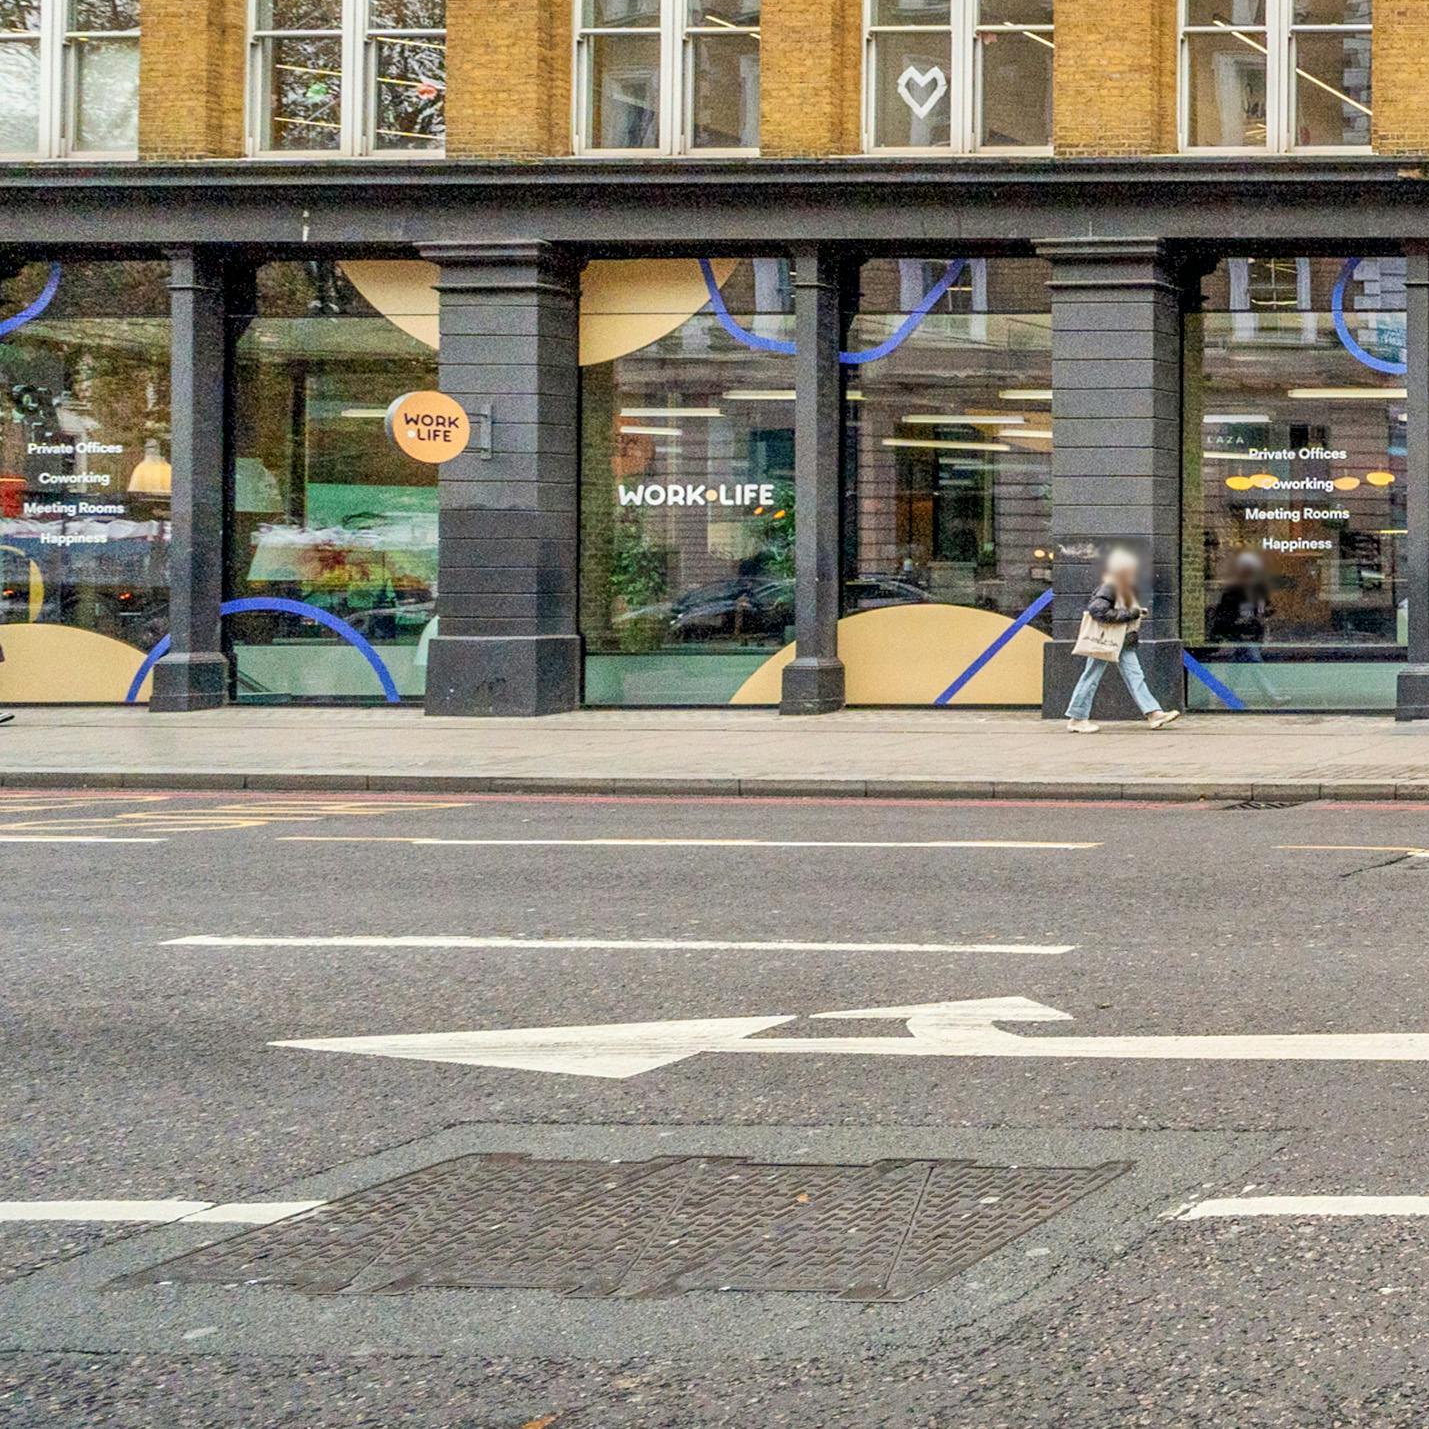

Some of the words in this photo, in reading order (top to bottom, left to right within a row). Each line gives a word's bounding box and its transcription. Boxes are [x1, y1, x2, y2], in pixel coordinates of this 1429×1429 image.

[404, 413, 459, 429] WORK
[28, 443, 73, 455] Private
[76, 442, 123, 454] Offices
[1249, 448, 1296, 459] Private
[1300, 447, 1347, 459] Offices
[39, 472, 110, 486] Coworking
[1262, 477, 1334, 492] Coworking
[24, 502, 76, 516] Meeting
[79, 502, 124, 513] Rooms
[1245, 508, 1300, 521] Meeting
[1304, 508, 1350, 519] Rooms
[41, 533, 107, 546] Happiness
[1263, 537, 1332, 552] Happiness
